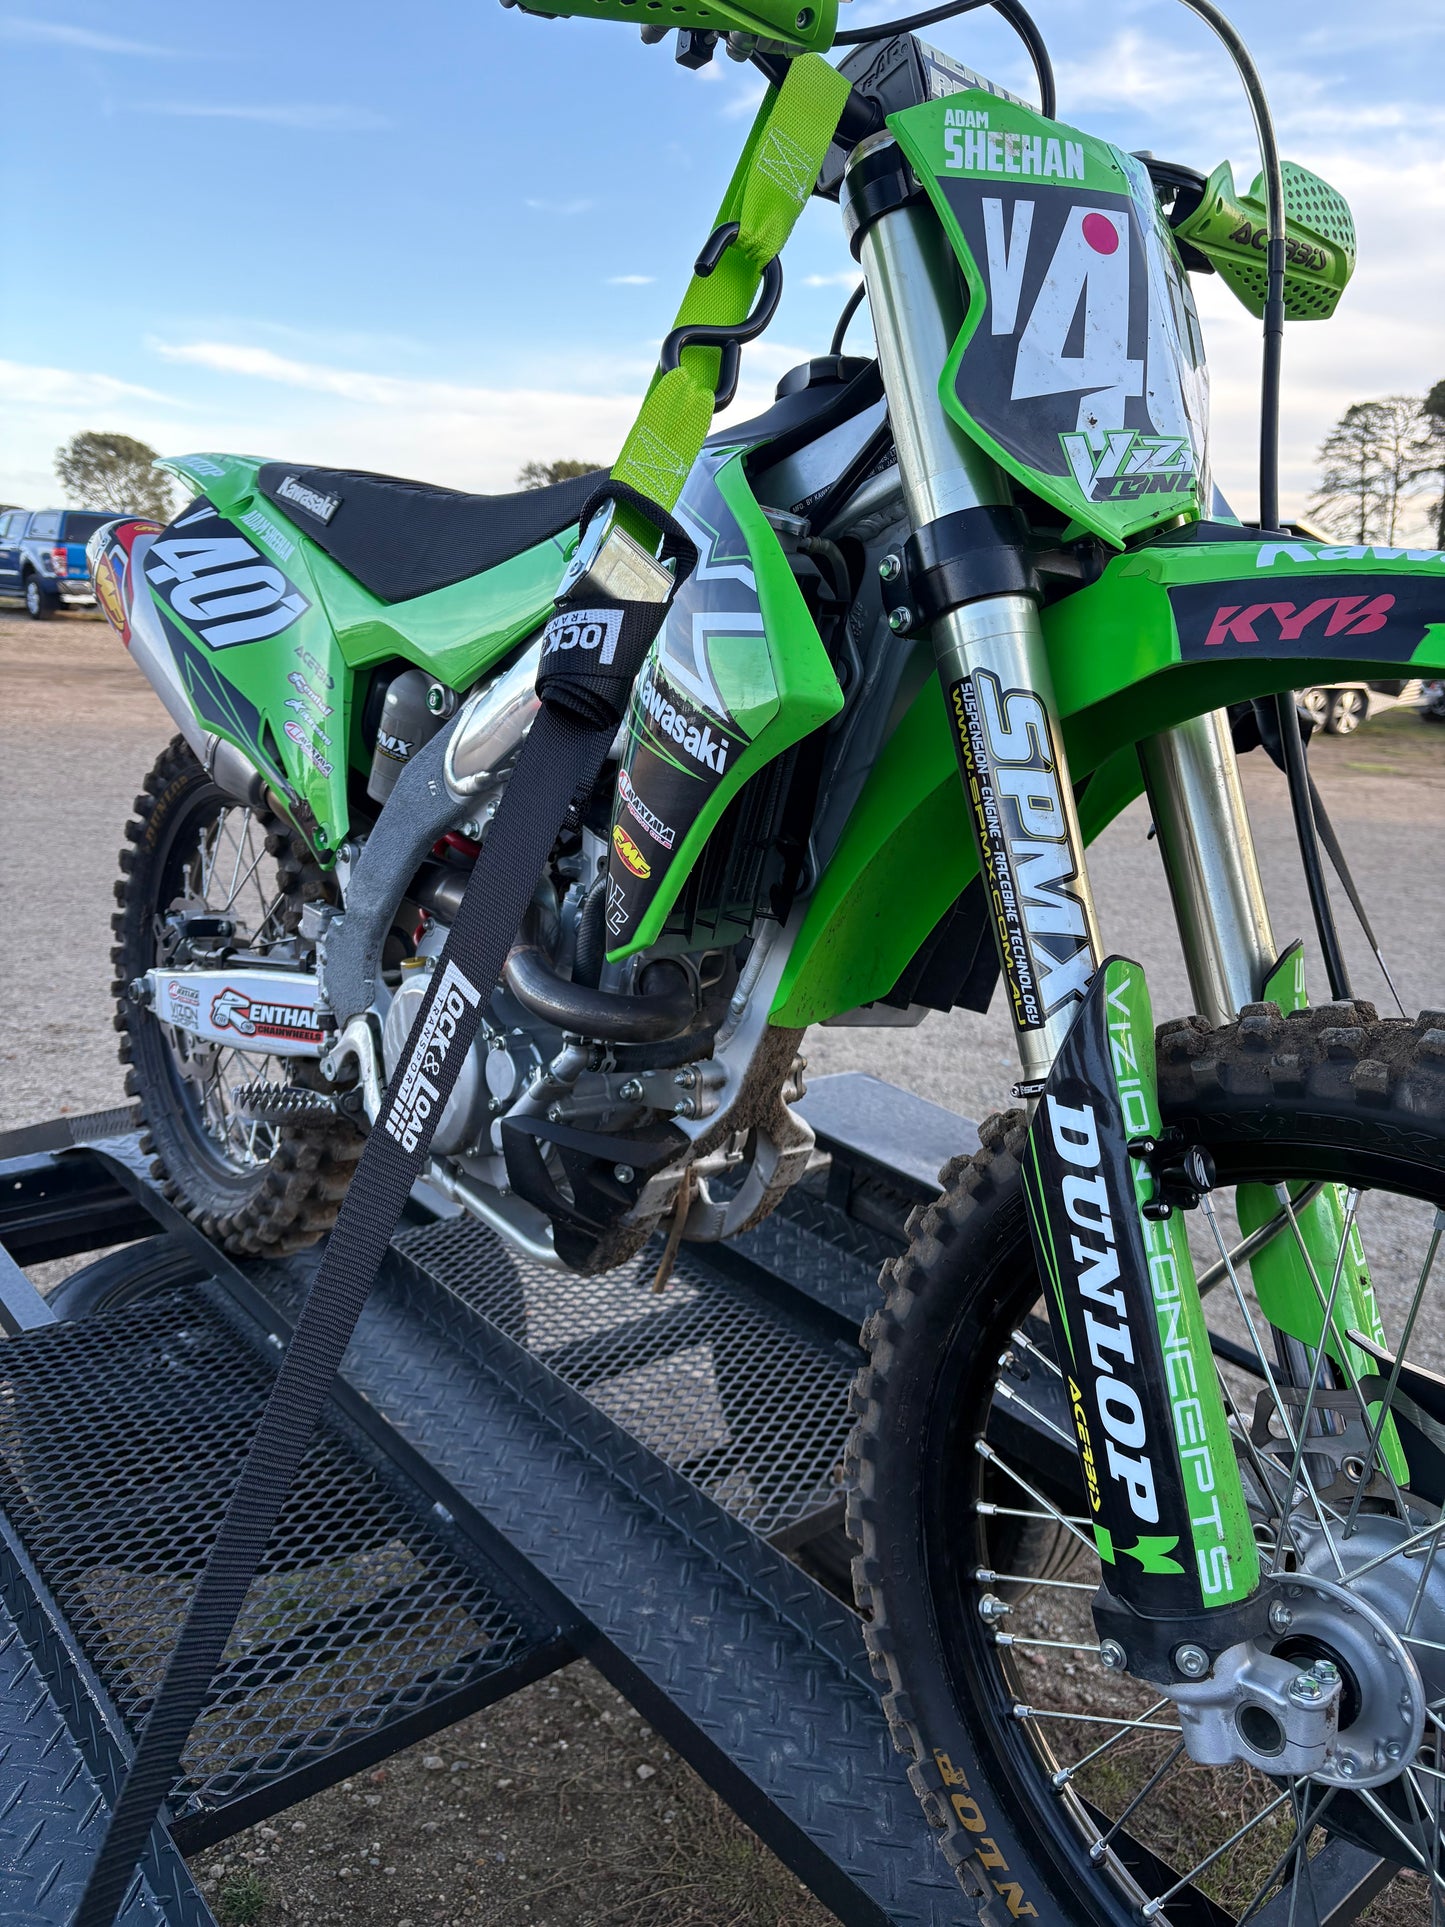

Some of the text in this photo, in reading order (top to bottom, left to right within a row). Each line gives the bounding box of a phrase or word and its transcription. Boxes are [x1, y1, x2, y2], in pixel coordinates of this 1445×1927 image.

[944, 108, 989, 129] ADAM
[944, 128, 1085, 181] SHEEHAN
[1229, 221, 1327, 271] ACRBIS
[276, 476, 341, 519] Kawasaki
[239, 510, 296, 562] ADAM SHEEHAN
[145, 537, 310, 648] 401
[1204, 593, 1396, 646] KYB
[641, 679, 730, 775] awasaki
[625, 788, 677, 842] MAXIMA
[613, 826, 651, 874] FMF
[952, 687, 1027, 1026] WWW.SPMX.COM.AU
[961, 682, 989, 775] SUSPENSION
[981, 786, 1002, 838] ENGINE
[993, 851, 1019, 923] RACEBIKE
[1009, 927, 1041, 1025] TECHNOLOGY
[976, 671, 1096, 1017] SPMX
[257, 1025, 322, 1042] CHAINWHEELS
[401, 996, 444, 1096] TRANSPORT
[401, 958, 482, 1154] LOCK & LOAD
[1046, 1093, 1160, 1524] DUNLOP
